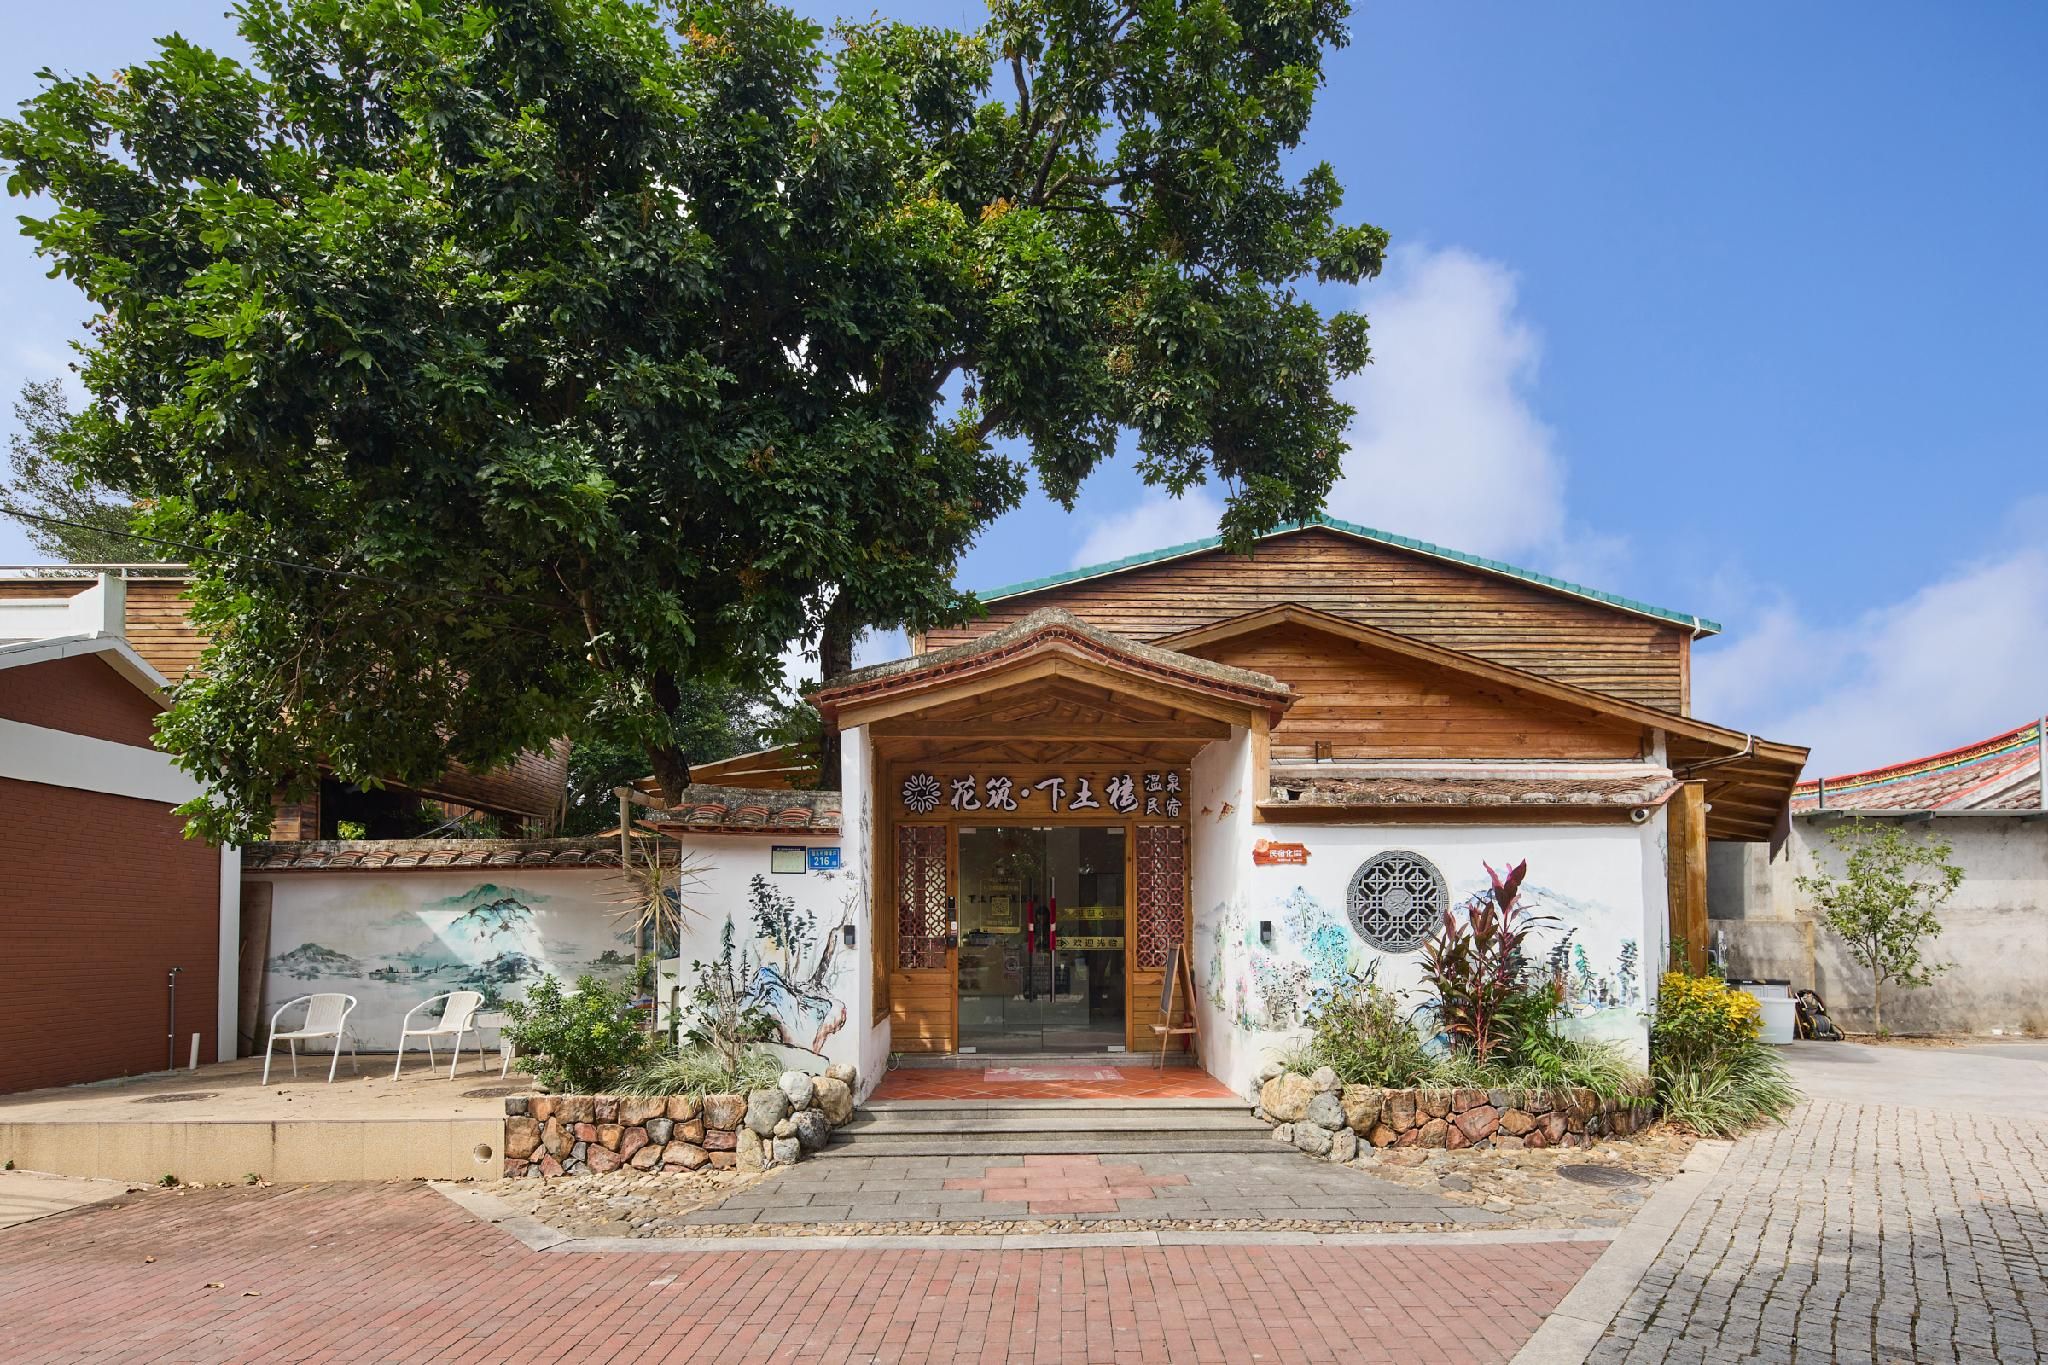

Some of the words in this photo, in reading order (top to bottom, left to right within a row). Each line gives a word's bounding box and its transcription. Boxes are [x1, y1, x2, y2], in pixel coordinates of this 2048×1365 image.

[1146, 796, 1183, 817] 民宿
[814, 856, 830, 866] 216
[1073, 938, 1118, 947] 欢迎光临
